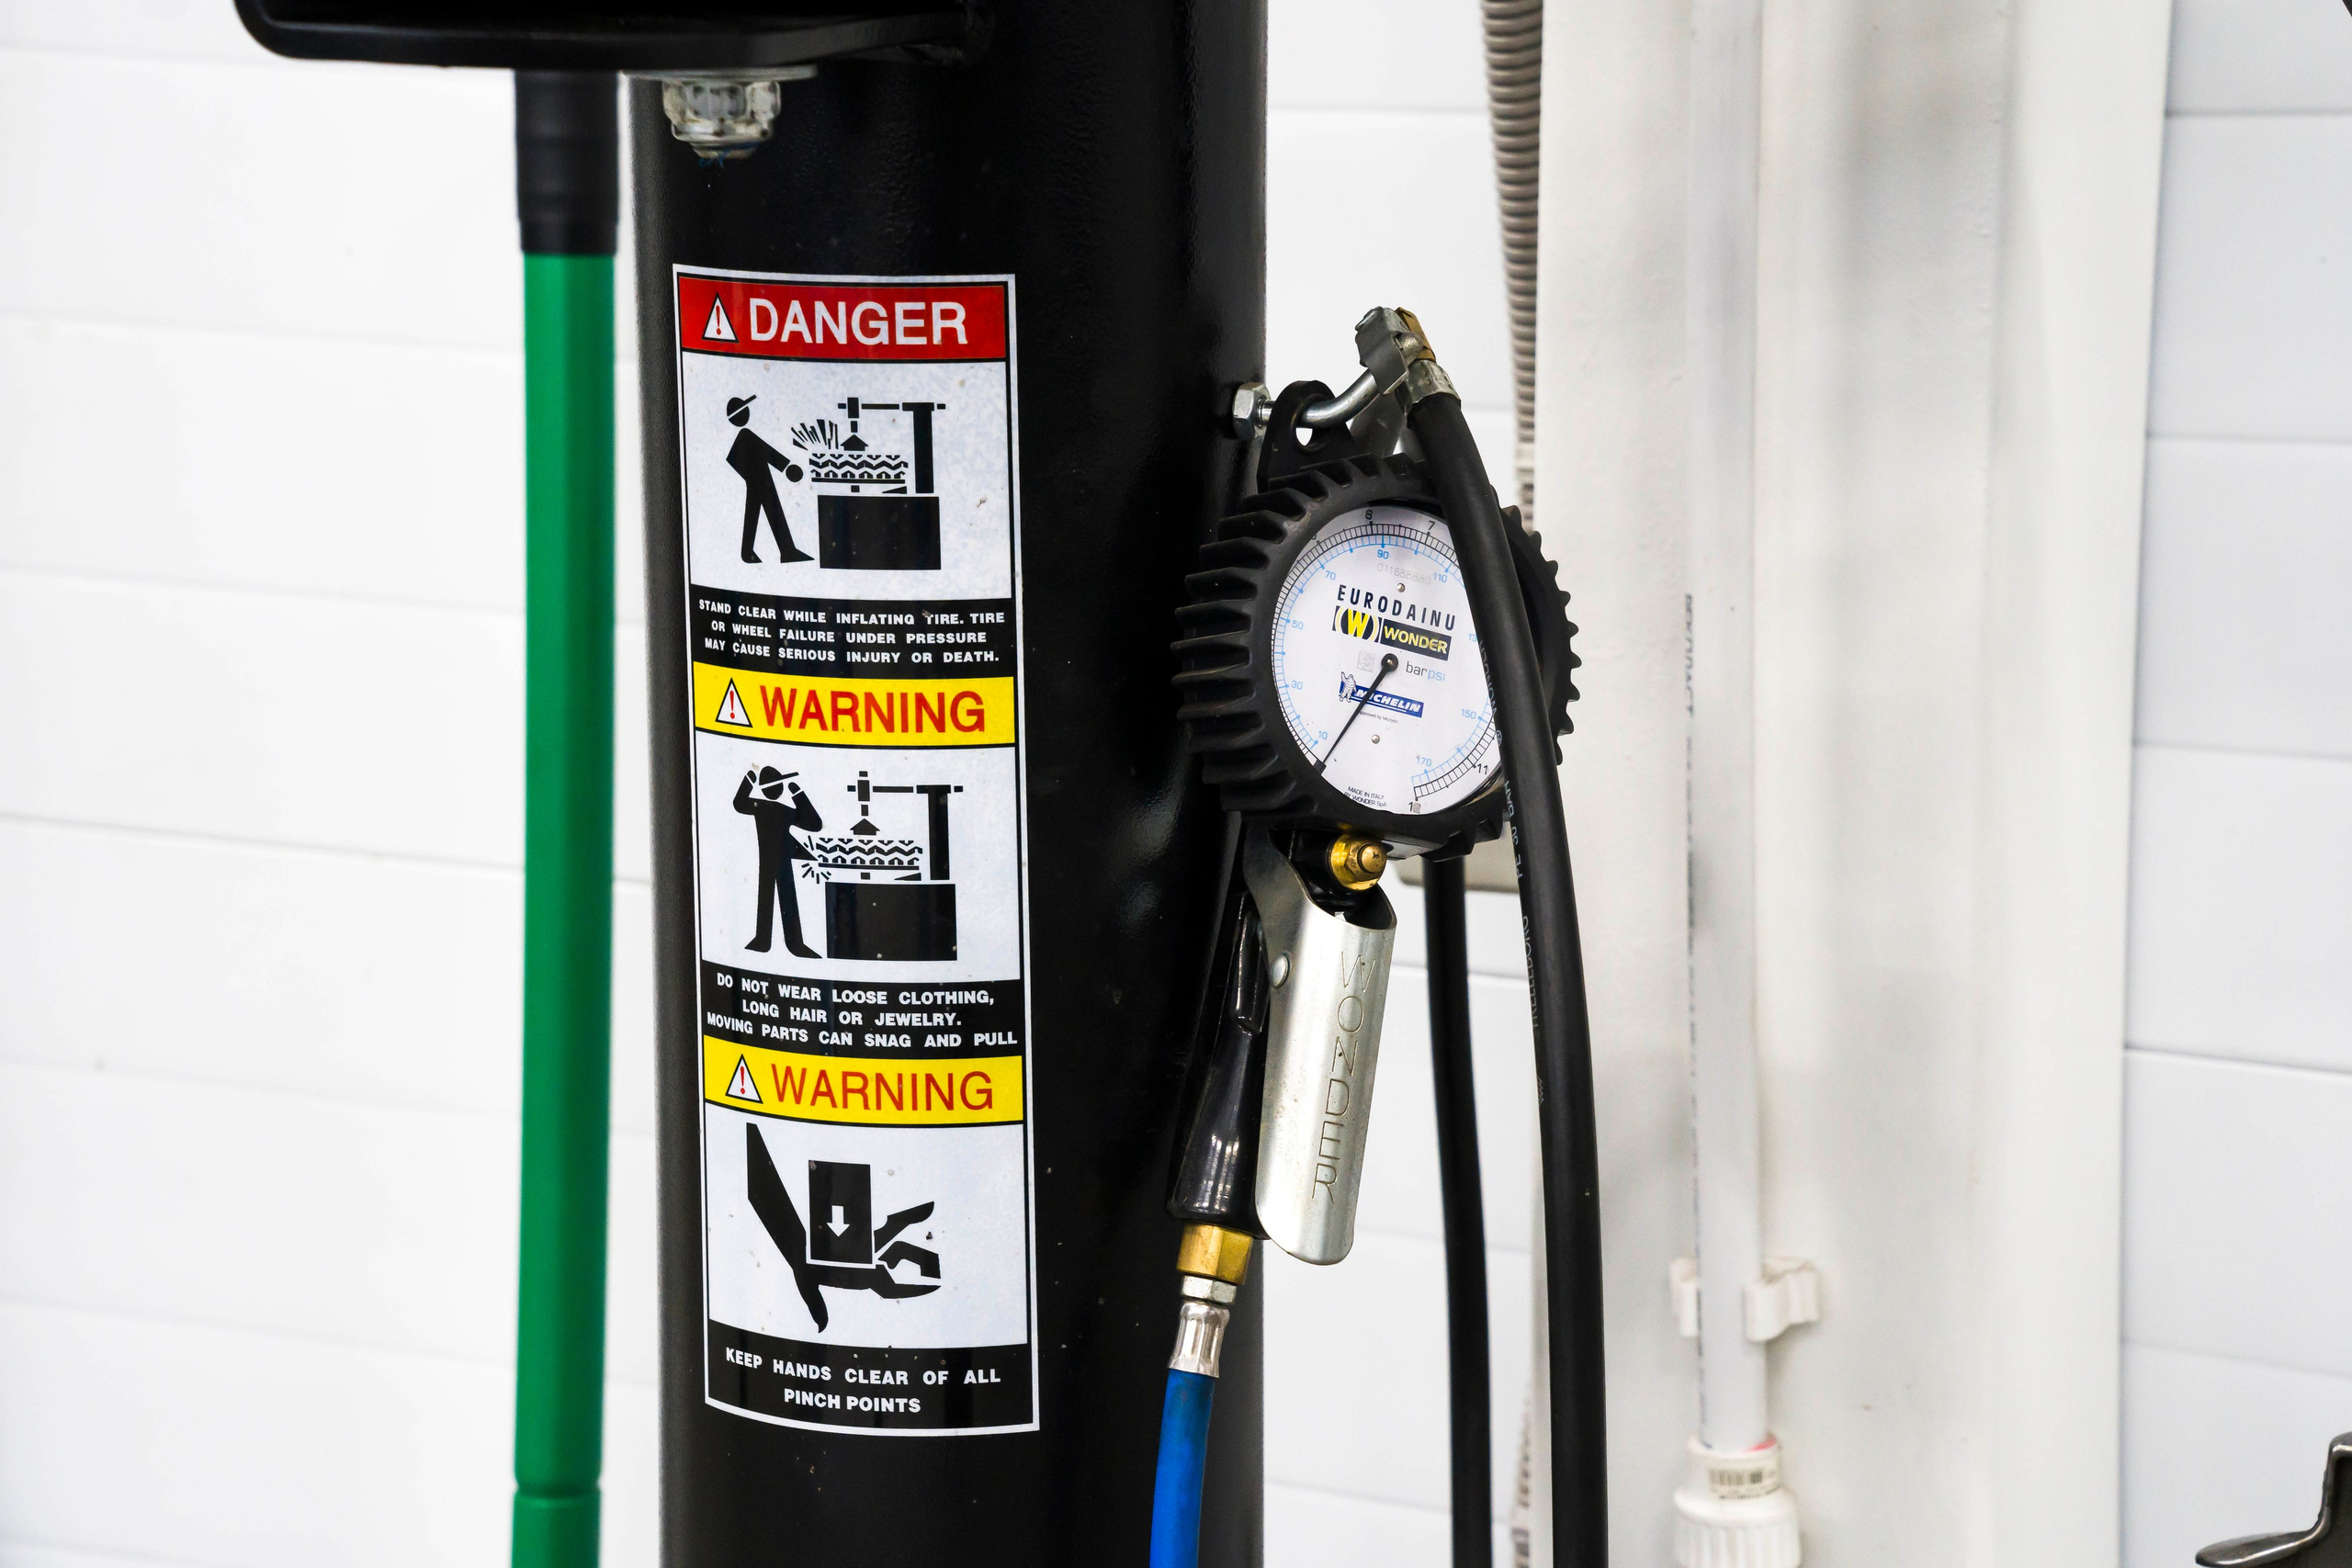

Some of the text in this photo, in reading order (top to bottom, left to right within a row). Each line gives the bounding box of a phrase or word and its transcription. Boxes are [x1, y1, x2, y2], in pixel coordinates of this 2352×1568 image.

[749, 297, 968, 345] DANGER
[1365, 509, 1374, 520] 6
[1428, 520, 1436, 531] 7
[1377, 549, 1389, 559] 90
[1325, 570, 1337, 581] 70
[1433, 572, 1448, 583] 110
[699, 599, 1004, 626] STAND CLEAR WHILE INFLATING TIRE. TIRE
[1337, 584, 1455, 631] EURODAINU
[711, 620, 987, 644] OR WHEEL FAILURE UNDER PRESSURE
[1291, 620, 1304, 630] 50
[1384, 626, 1448, 655] WONDER
[1468, 633, 1477, 643] 13
[705, 637, 999, 663] MAY CAUSE SERIOUS INJURY OR DEATH.
[1291, 680, 1303, 690] 30
[760, 684, 985, 733] WARNING
[1461, 708, 1477, 719] 150
[1317, 730, 1329, 740] 10
[1417, 756, 1432, 767] 170
[1477, 763, 1488, 775] 11
[1348, 786, 1363, 796] MADE
[1351, 795, 1376, 806] WONDER
[718, 972, 994, 1006] DO NOT WEAR LOOSE CLOTHING,
[742, 999, 962, 1027] LONG HAIR OR JEWELRY.
[707, 1011, 1018, 1047] MOVING PARTS CAN SNAG AND PULL
[1311, 951, 1376, 1204] WONDER
[771, 1063, 993, 1111] WARNING
[726, 1347, 1001, 1385] KEEP HANDS CLEAR OF ALL
[784, 1388, 921, 1413] PINCH POINTS
